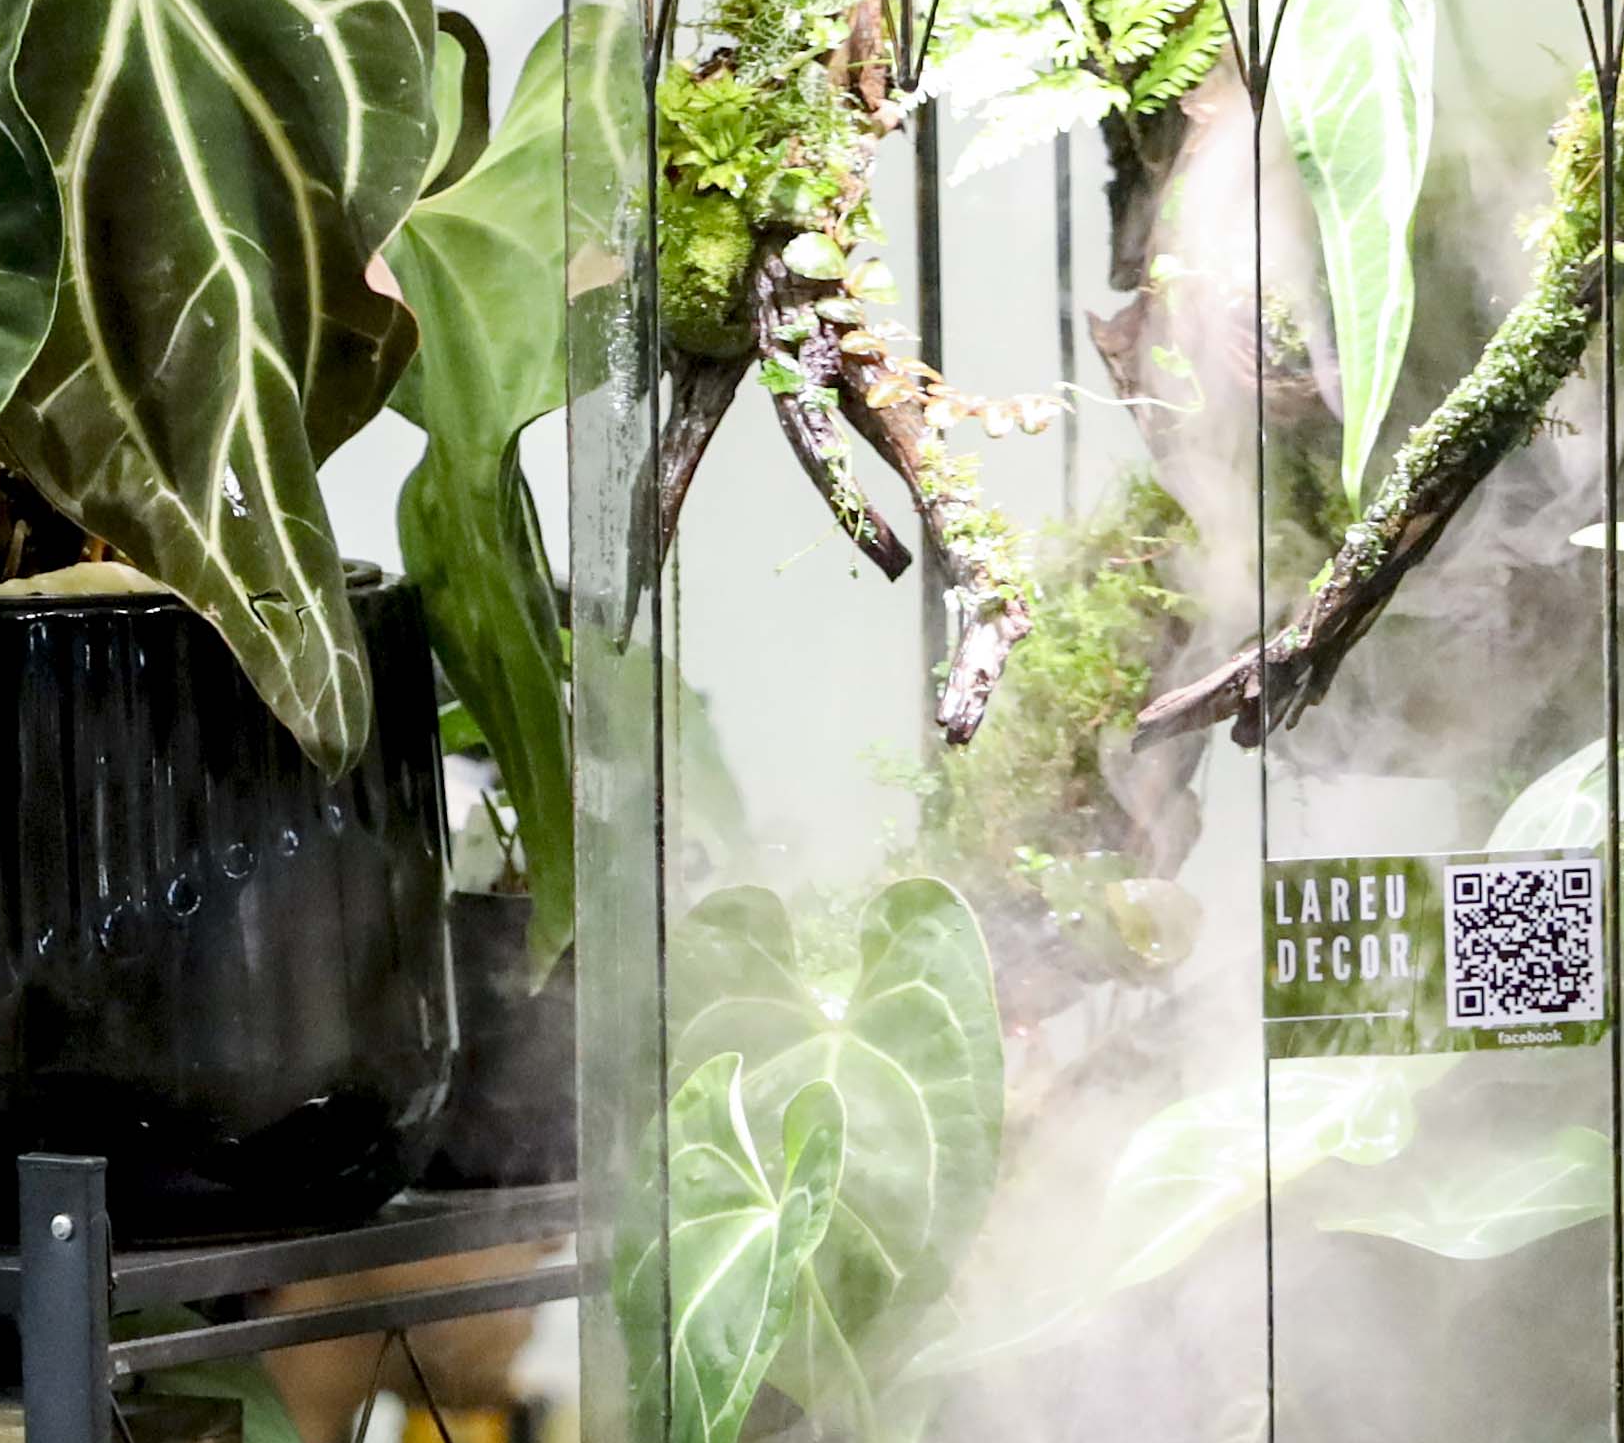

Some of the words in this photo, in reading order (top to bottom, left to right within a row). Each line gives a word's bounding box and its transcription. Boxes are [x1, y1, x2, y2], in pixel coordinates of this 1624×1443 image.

[1274, 874, 1407, 925] LAREU
[1277, 933, 1410, 984] DECOR
[1497, 1029, 1563, 1045] facebook
